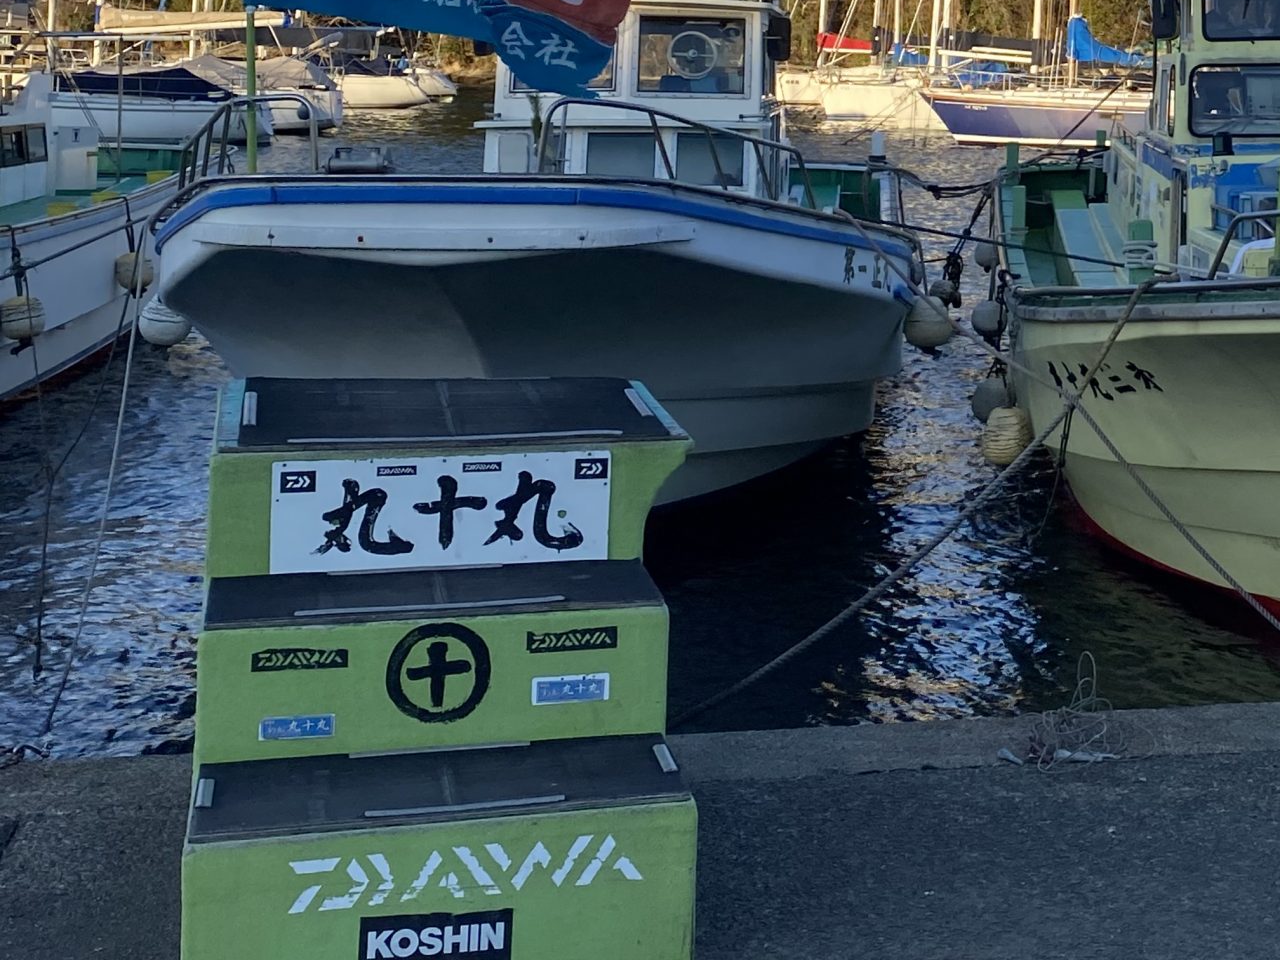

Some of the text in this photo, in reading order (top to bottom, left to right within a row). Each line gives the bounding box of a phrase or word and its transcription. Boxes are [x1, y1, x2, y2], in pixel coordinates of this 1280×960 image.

[311, 470, 584, 555] 丸十丸
[366, 922, 505, 959] KOSHIN
